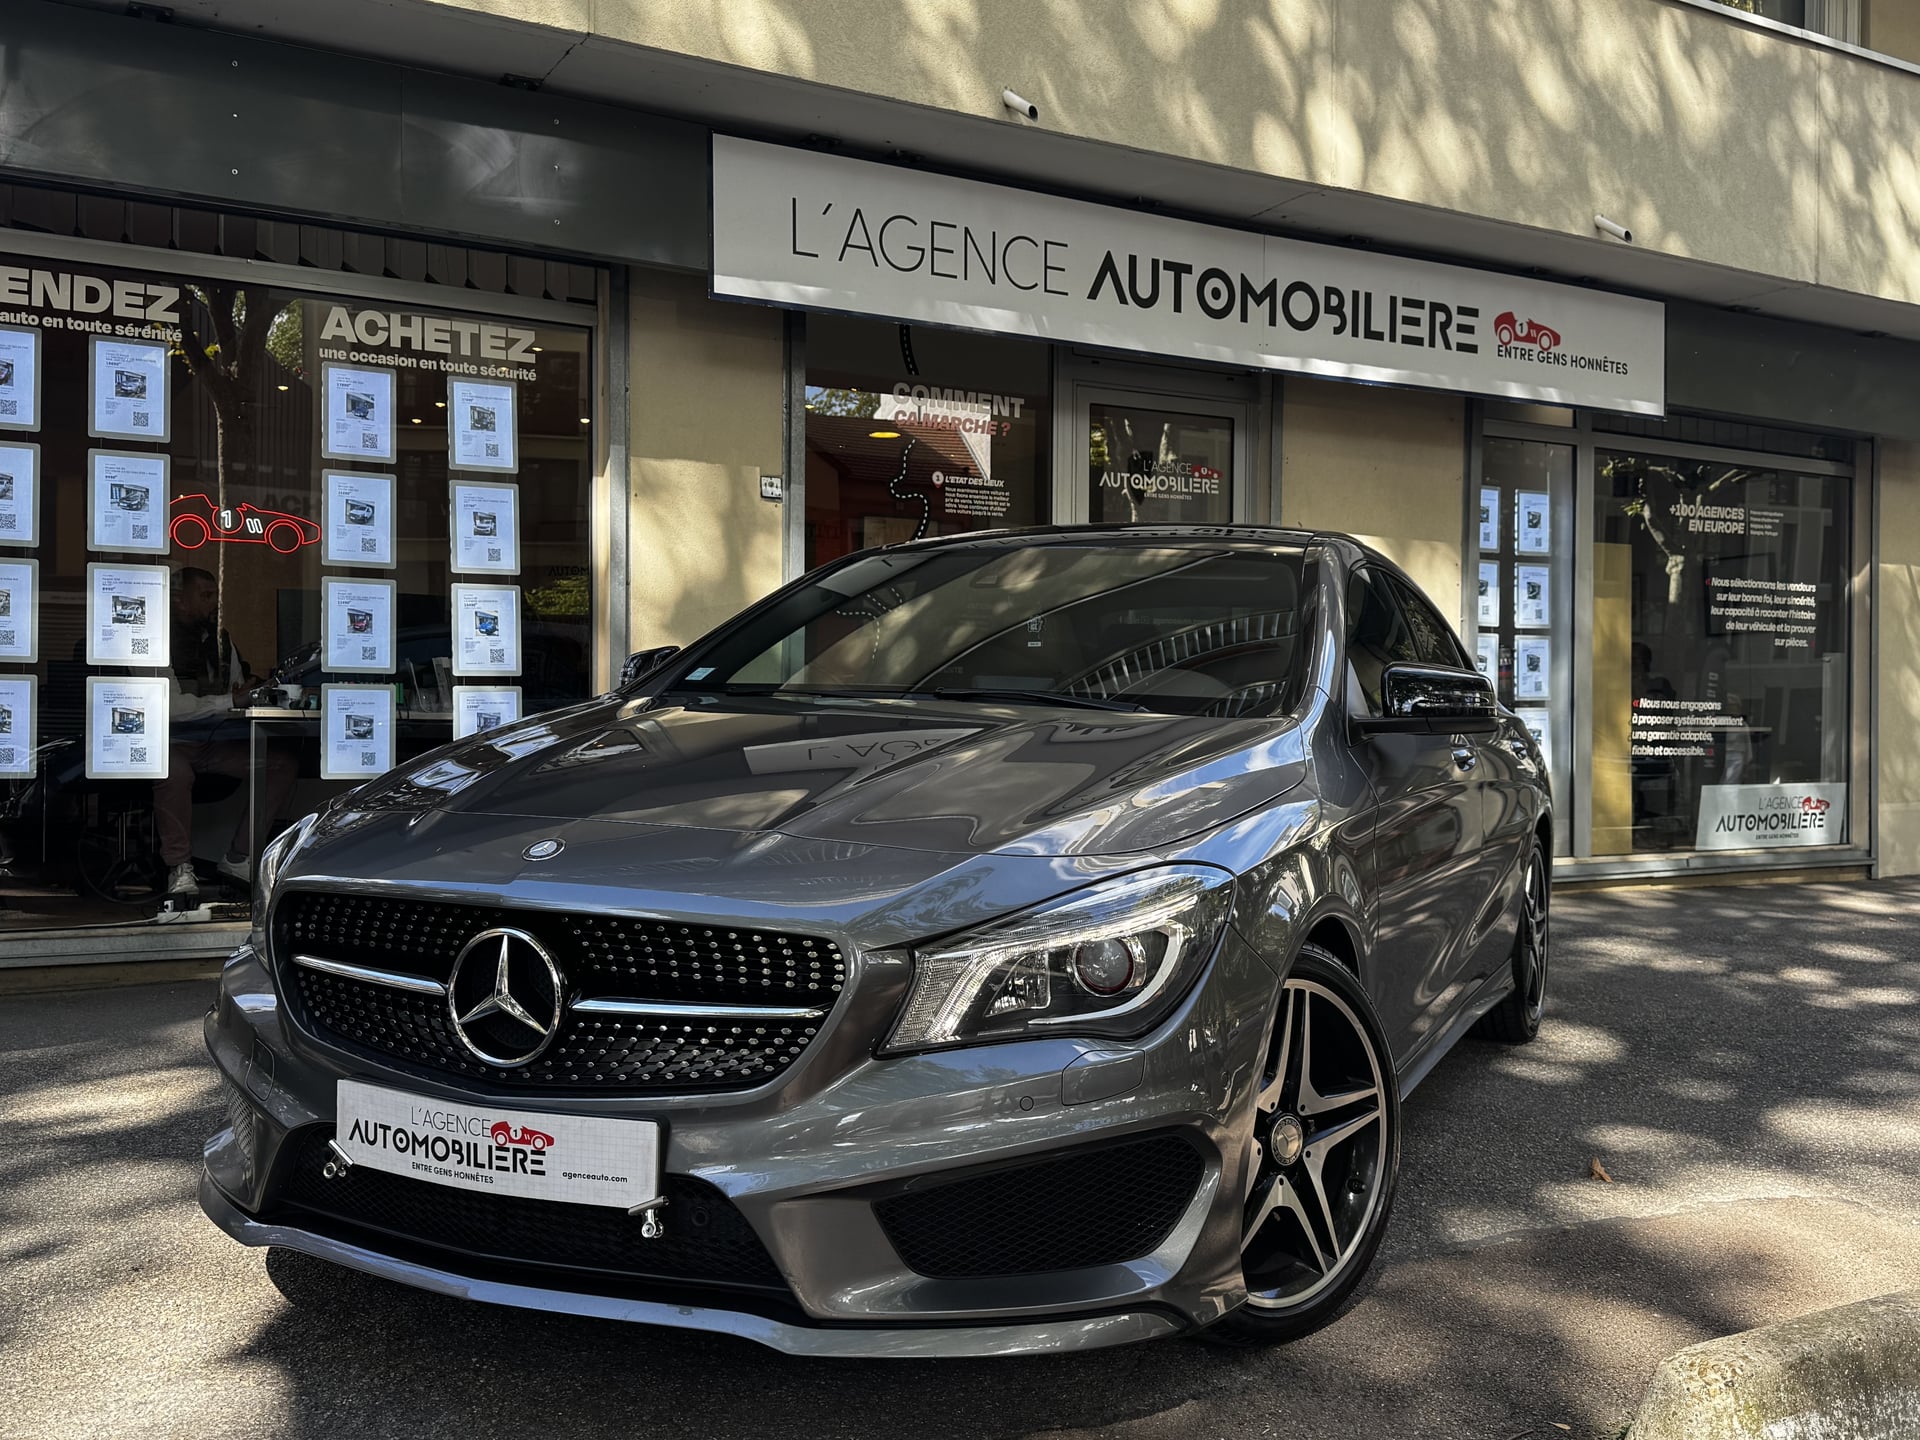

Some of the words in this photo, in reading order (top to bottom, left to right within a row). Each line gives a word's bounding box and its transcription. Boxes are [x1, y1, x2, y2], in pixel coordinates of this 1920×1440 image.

[1086, 250, 1479, 355] AUTOMOBILIERE
[0, 311, 39, 325] auto
[42, 316, 63, 328] en
[67, 316, 112, 334] toute
[115, 323, 183, 342] sérénité
[320, 306, 536, 363] ACHETEZ
[319, 348, 347, 361] une
[349, 351, 417, 368] occasion
[419, 359, 438, 370] en
[440, 358, 477, 375] toute
[480, 364, 537, 381] sécurité
[1497, 344, 1534, 361] ENTRE
[1537, 350, 1567, 367] GENS
[1570, 355, 1628, 375] HONNÊTES
[892, 382, 1024, 419] COMMENT
[922, 413, 998, 435] MARCHE
[968, 478, 984, 486] DES
[983, 479, 1005, 488] LIEUX
[1099, 472, 1219, 494] AUTOMOBILIERE
[1696, 505, 1745, 520] AGENCES
[1688, 519, 1704, 532] EN
[1704, 520, 1745, 534] EUROPE
[1711, 577, 1730, 588] Nous
[1776, 581, 1786, 590] les
[1787, 582, 1816, 593] vendeurs
[1716, 593, 1728, 601] sur
[1728, 592, 1741, 602] leur
[1741, 593, 1762, 603] bonne
[1774, 595, 1786, 605] leur
[1710, 605, 1725, 615] leur
[1725, 620, 1735, 630] de
[1777, 624, 1784, 632] et
[1774, 638, 1786, 646] sur
[1639, 698, 1660, 709] Nous
[1660, 700, 1680, 710] nous
[1680, 701, 1722, 712] engageons
[1638, 715, 1673, 726] proposer
[1632, 731, 1647, 740] une
[1647, 730, 1680, 741] garantie
[1654, 745, 1663, 755] et
[1715, 812, 1825, 832] AUTOMOBILIERE
[411, 1106, 491, 1138] L'AGENCE
[349, 1118, 546, 1177] AUTOMOBILIERE
[412, 1162, 433, 1174] ENTRE
[434, 1167, 453, 1177] GENS
[454, 1170, 494, 1184] HONNÊTES
[562, 1170, 628, 1184] agenceauto.com
